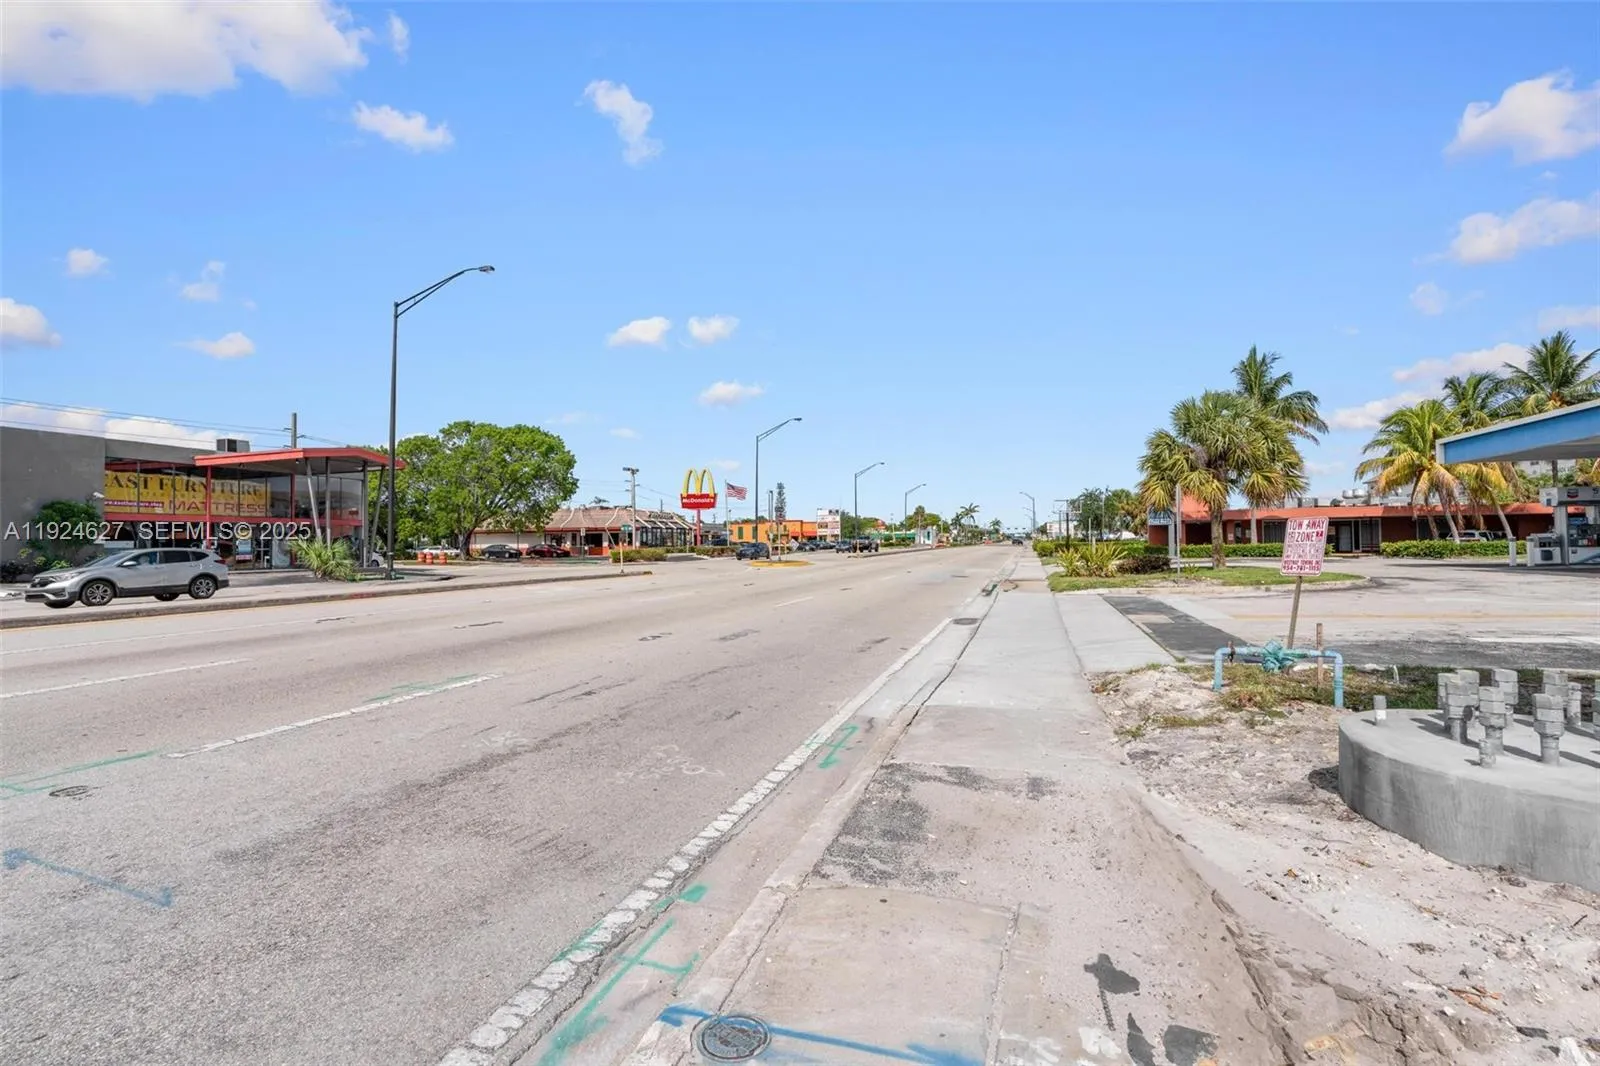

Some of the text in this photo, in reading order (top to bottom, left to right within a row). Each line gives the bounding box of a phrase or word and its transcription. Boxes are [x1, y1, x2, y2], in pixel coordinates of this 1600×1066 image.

[159, 477, 263, 496] FURNITURE
[168, 499, 266, 513] MATTRESS
[1289, 519, 1326, 531] TOW AWAY
[1295, 531, 1315, 543] ZONE
